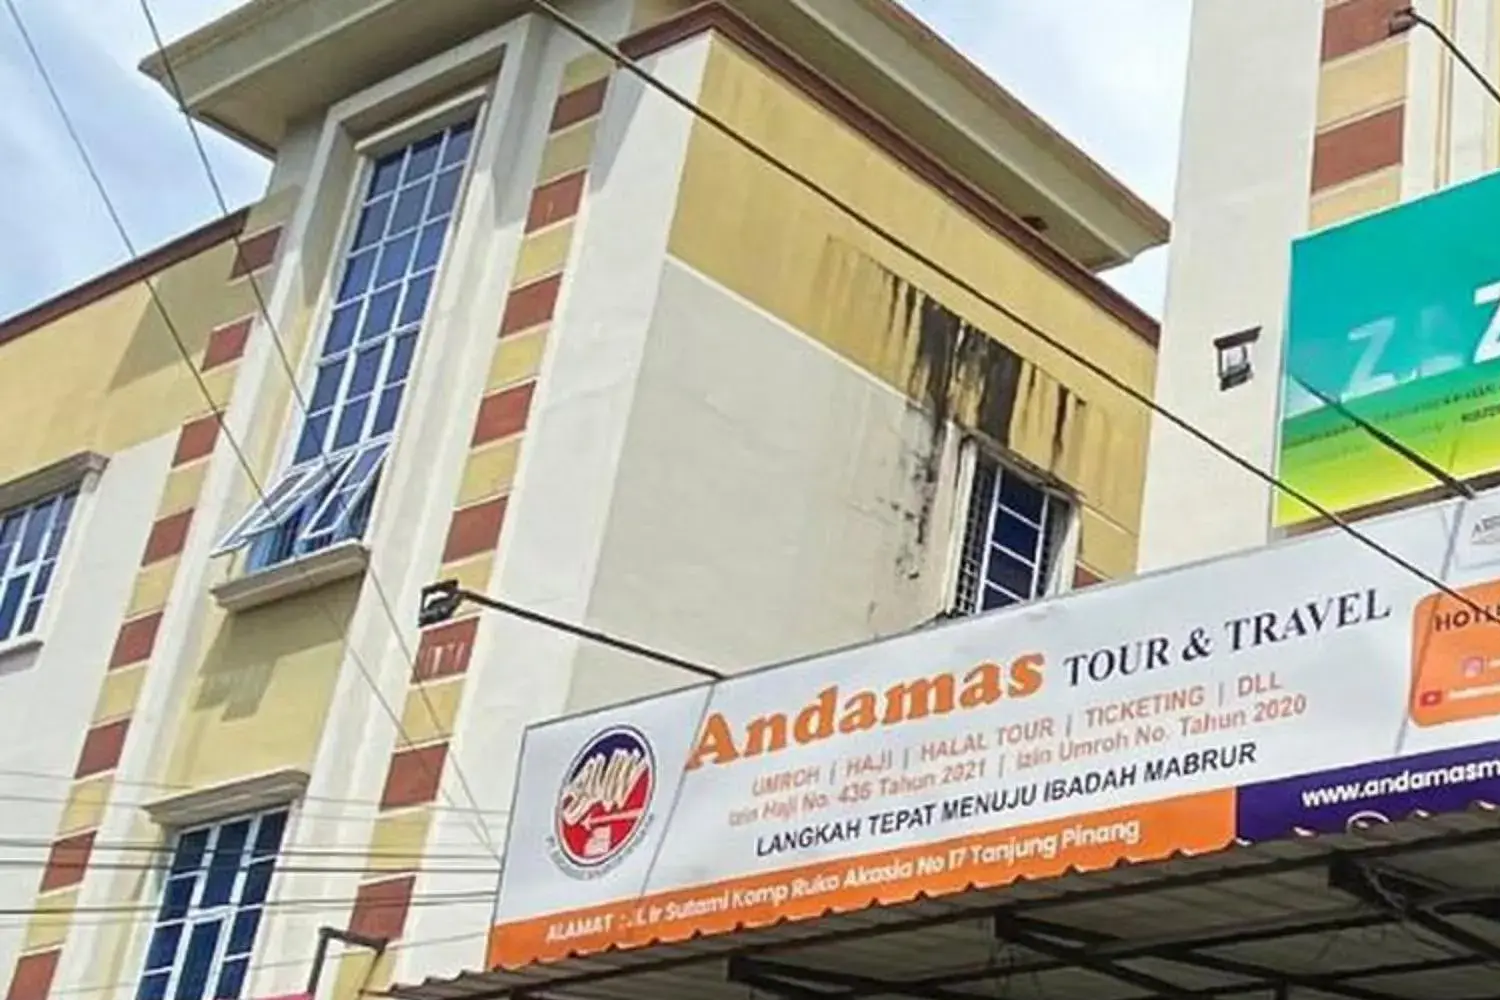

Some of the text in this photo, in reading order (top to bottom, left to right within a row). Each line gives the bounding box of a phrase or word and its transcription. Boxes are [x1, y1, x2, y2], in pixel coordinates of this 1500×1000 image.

[684, 588, 1392, 773] Andamas TOUR & TRAVEL
[752, 767, 820, 797] UMROH
[846, 748, 892, 778] HAJI
[921, 733, 987, 762] HALAL
[997, 716, 1055, 746] TOUR
[1085, 686, 1206, 731] TICKETING
[1238, 672, 1284, 698] DLL
[755, 740, 1258, 859] LANGKAH TEPAT MENUJU IBADAH MABRUR
[761, 796, 798, 823] Haji
[880, 769, 937, 797] Tahun
[941, 759, 987, 786] 2021
[1016, 749, 1052, 772] Izin
[1058, 732, 1129, 765] Umroh
[1134, 722, 1170, 746] No.
[1180, 707, 1248, 738] Tahun
[1253, 692, 1307, 725] 2020
[545, 914, 613, 944] ALAMAT
[731, 883, 789, 909] Komp
[791, 873, 840, 897] Ruko
[843, 858, 913, 888] Akasia
[916, 854, 944, 877] No
[948, 849, 967, 872] 17
[970, 834, 1058, 866] Tanjung
[1061, 818, 1140, 850] Pinang
